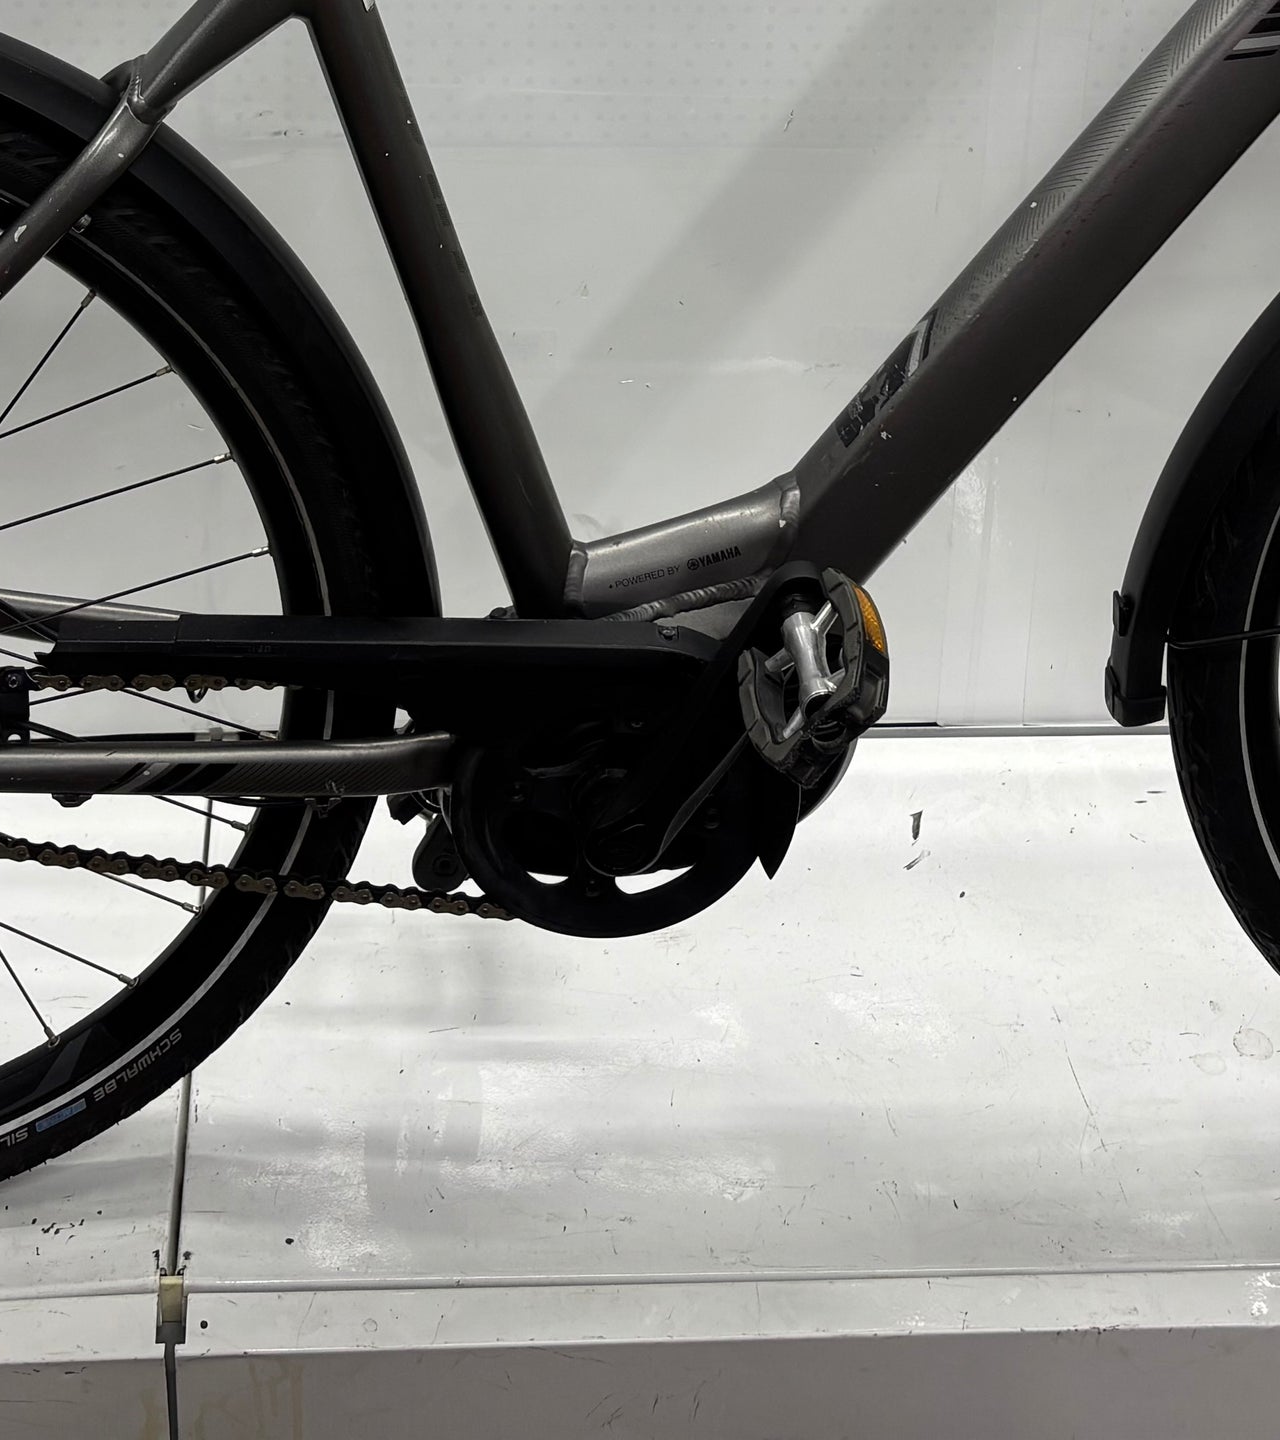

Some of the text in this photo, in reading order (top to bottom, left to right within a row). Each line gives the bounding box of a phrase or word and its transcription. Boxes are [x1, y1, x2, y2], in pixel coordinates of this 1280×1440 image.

[614, 545, 742, 589] POWERED BY YAMAHA
[93, 1028, 183, 1102] SCHWALBE
